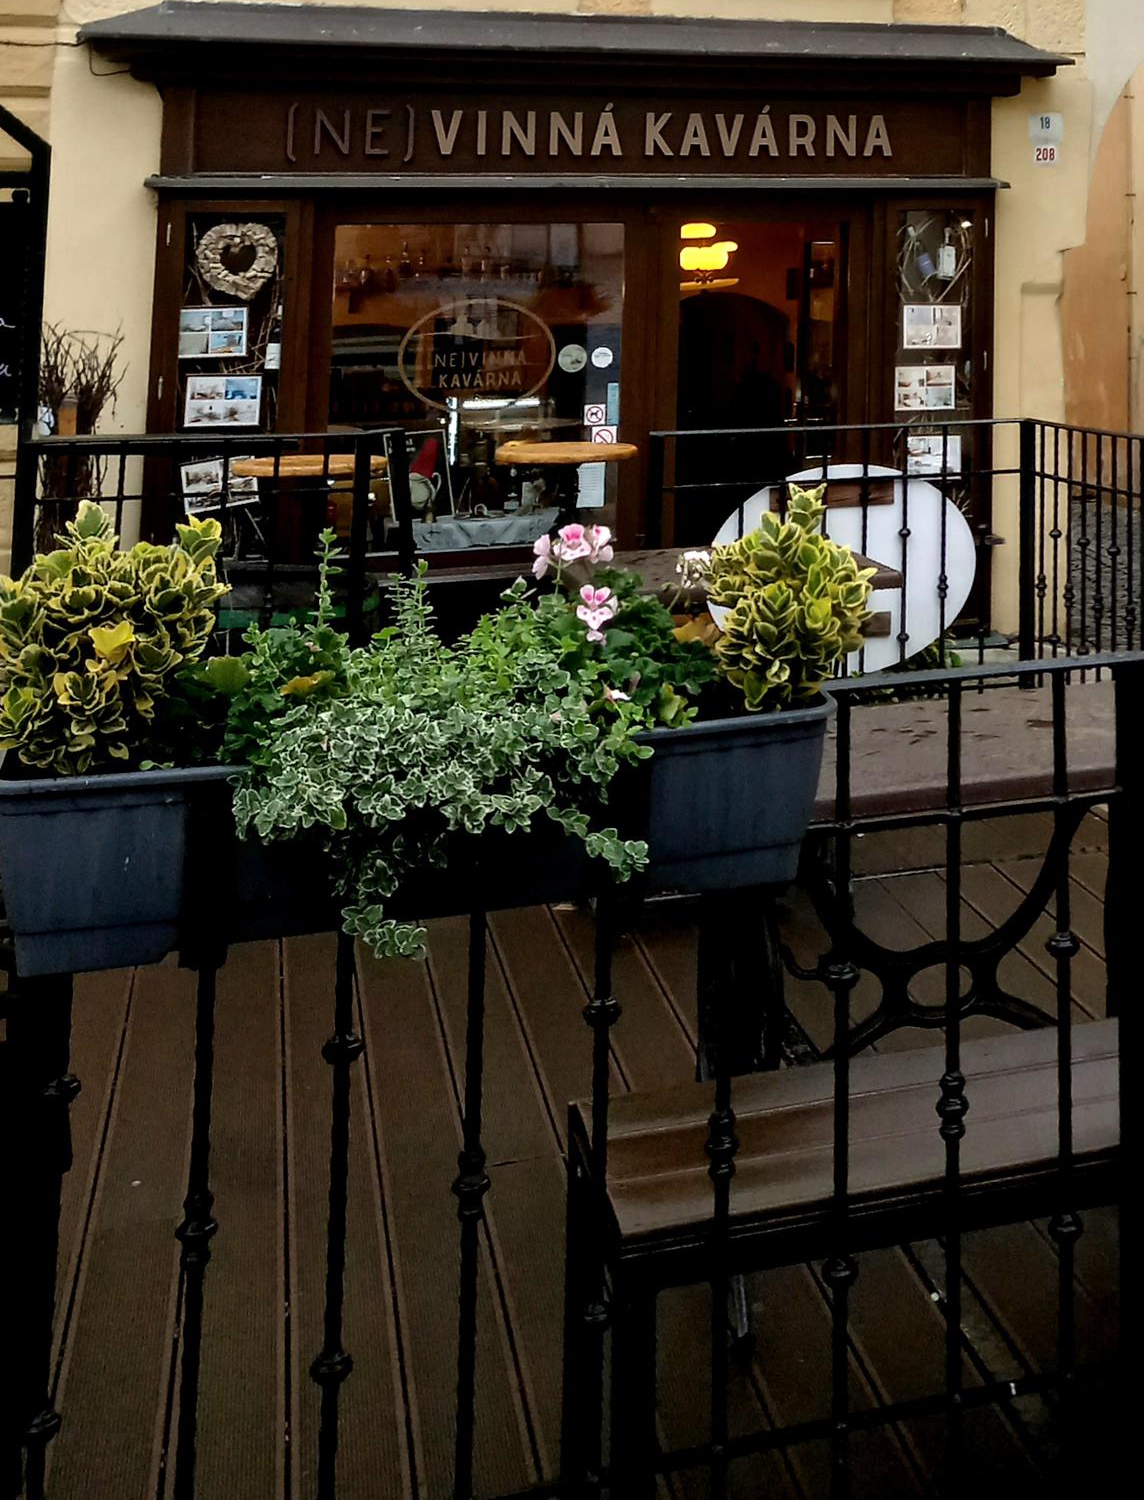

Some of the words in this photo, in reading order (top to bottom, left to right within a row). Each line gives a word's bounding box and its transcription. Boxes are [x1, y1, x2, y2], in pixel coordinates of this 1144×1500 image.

[1040, 116, 1050, 129] 18
[286, 103, 623, 163] (NE)VINNÁ
[644, 105, 893, 157] KAVÁRNA
[1036, 148, 1055, 161] 208
[439, 369, 521, 388] KAVÁRNA
